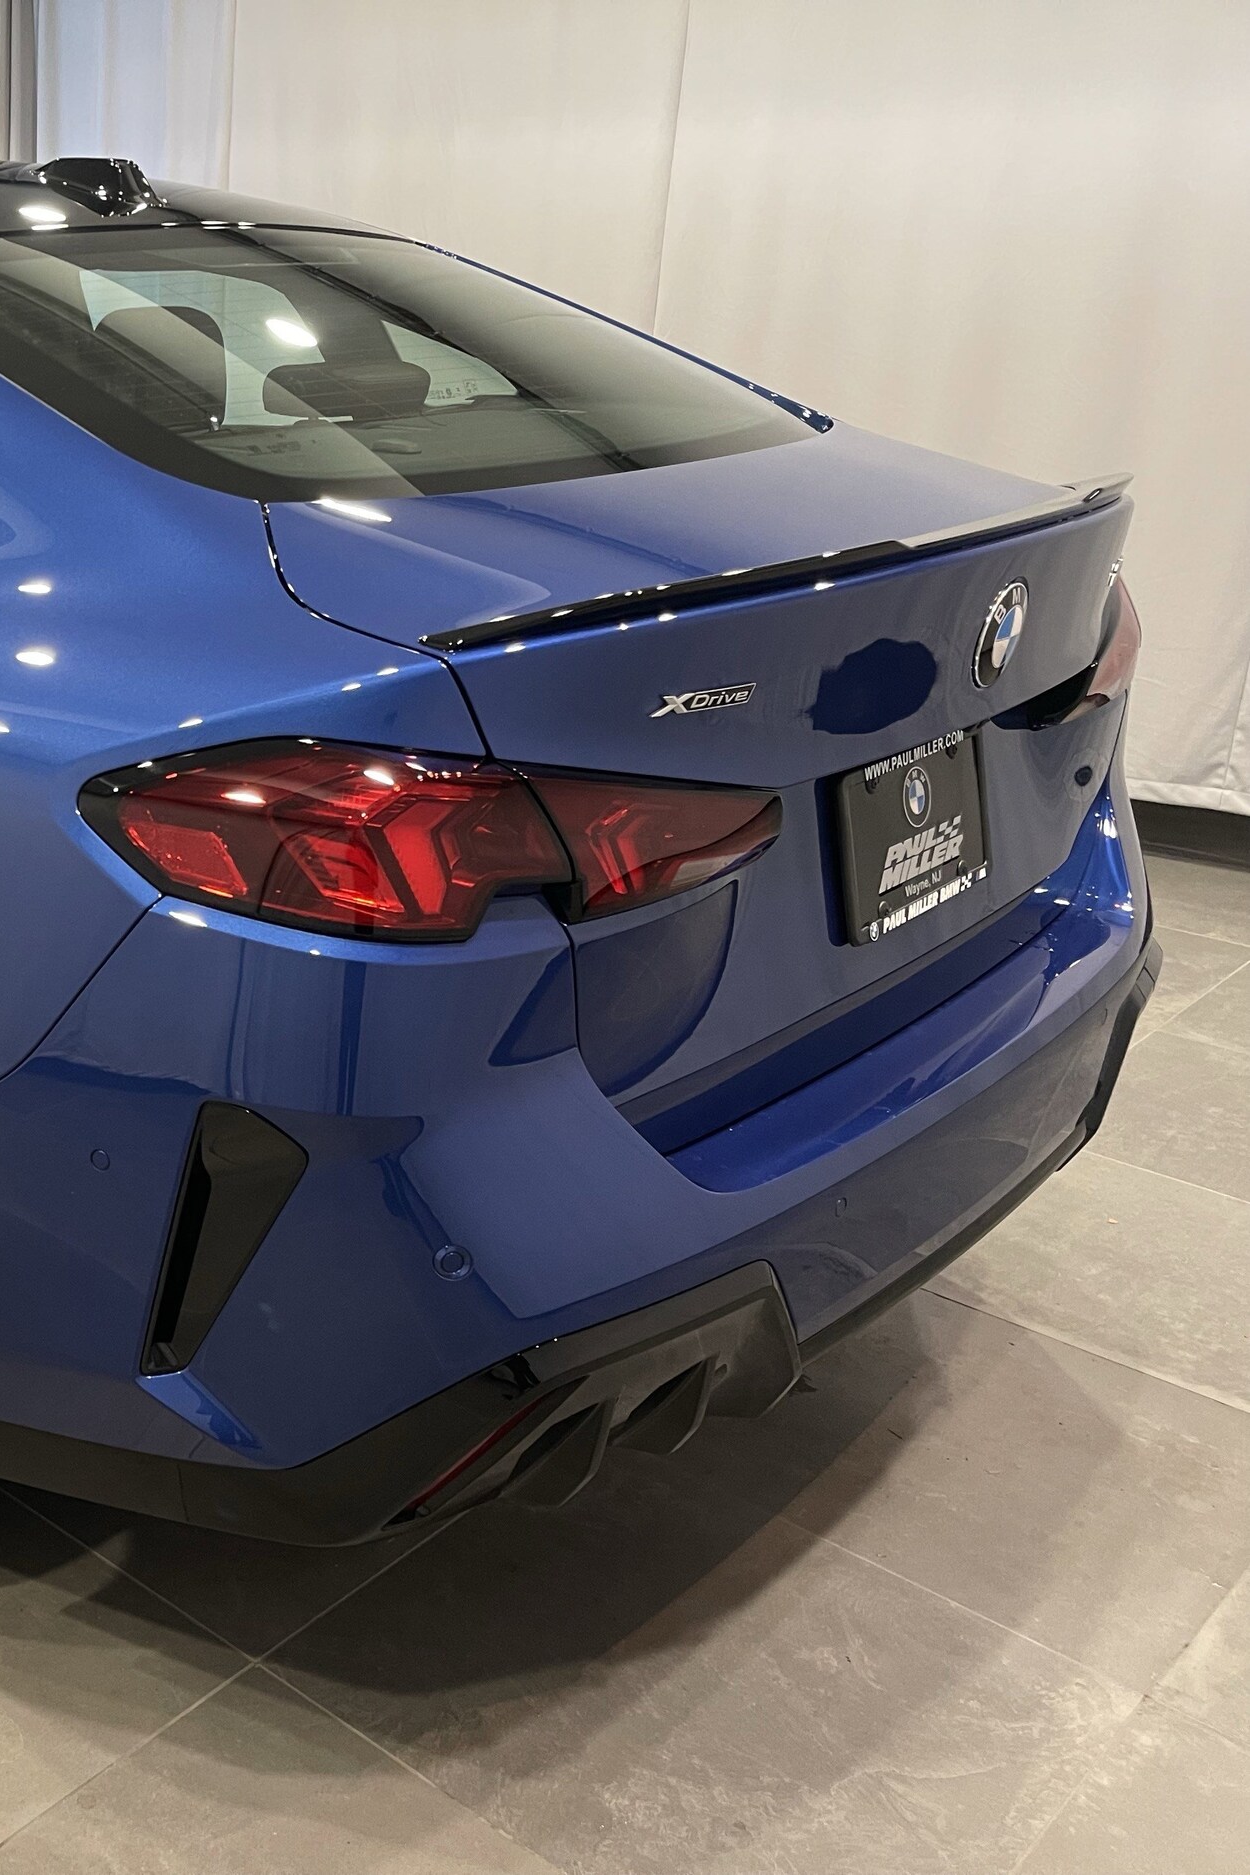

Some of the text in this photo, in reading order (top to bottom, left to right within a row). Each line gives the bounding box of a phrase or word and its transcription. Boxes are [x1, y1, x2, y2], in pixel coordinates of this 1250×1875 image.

[864, 729, 964, 781] WWW.PAULMILLER.COM
[879, 833, 964, 894] MILLER
[883, 826, 936, 869] PAUL
[931, 870, 942, 885] NJ
[882, 908, 907, 934] PAUL
[907, 891, 939, 921] MILLER
[939, 878, 961, 904] BMW
